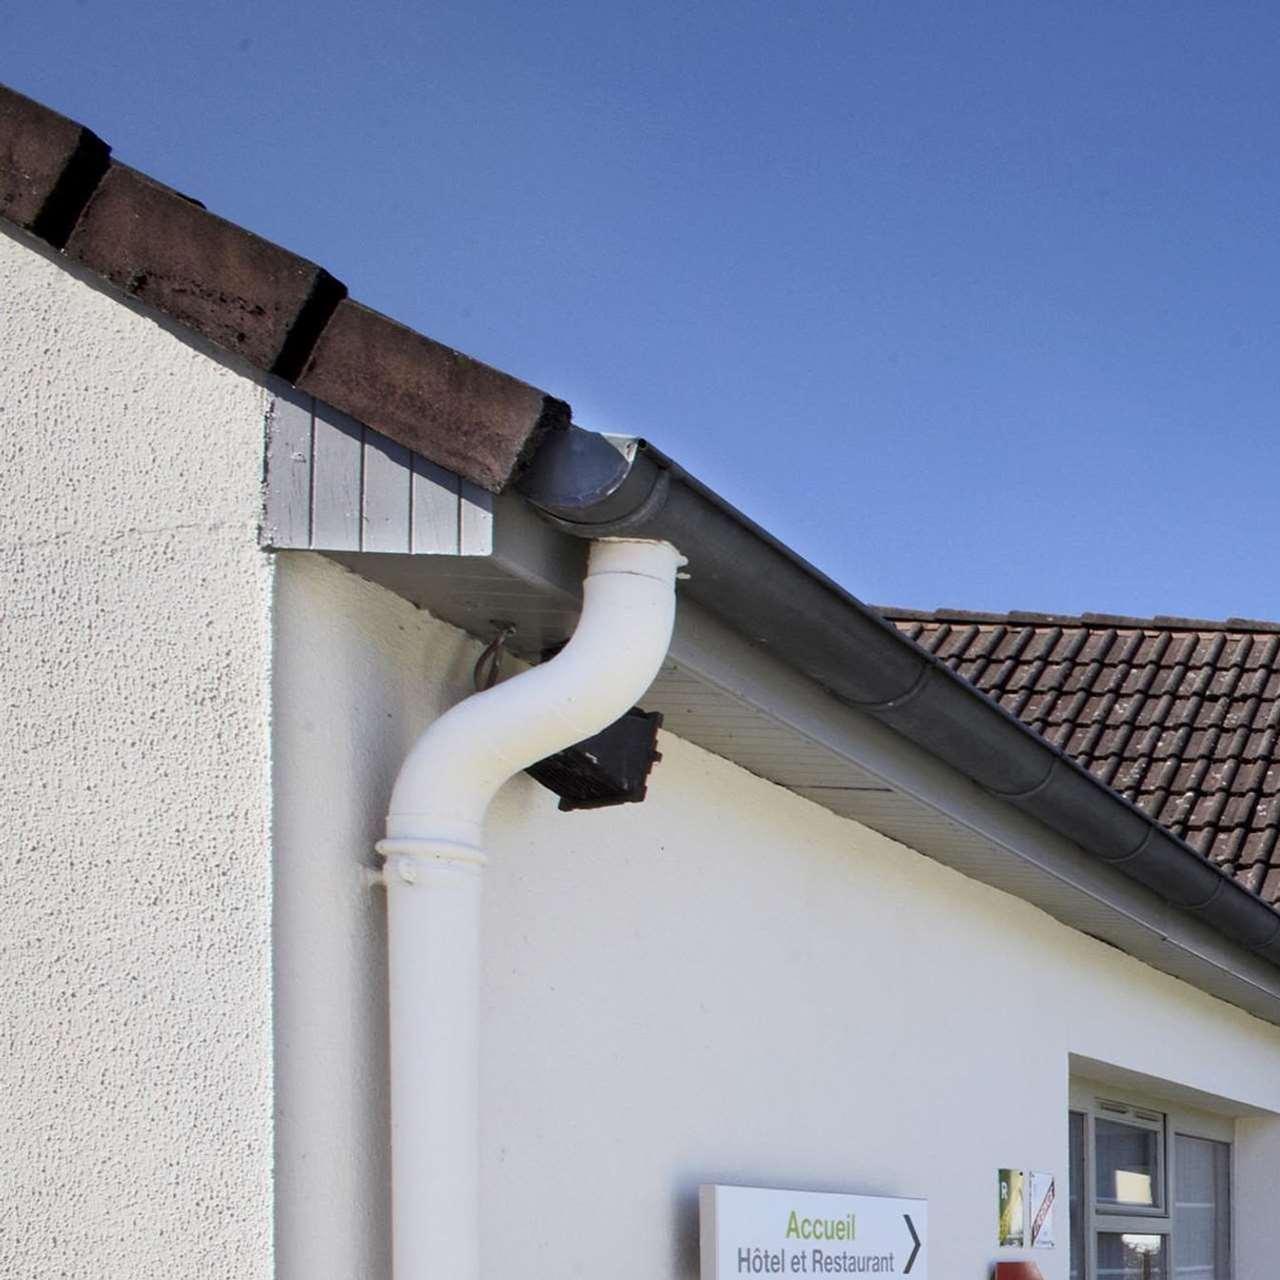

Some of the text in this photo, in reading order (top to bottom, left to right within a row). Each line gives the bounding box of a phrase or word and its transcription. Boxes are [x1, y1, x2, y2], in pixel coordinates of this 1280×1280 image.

[785, 1209, 856, 1242] Accueil
[737, 1246, 895, 1274] Hôtel et Restaurant
